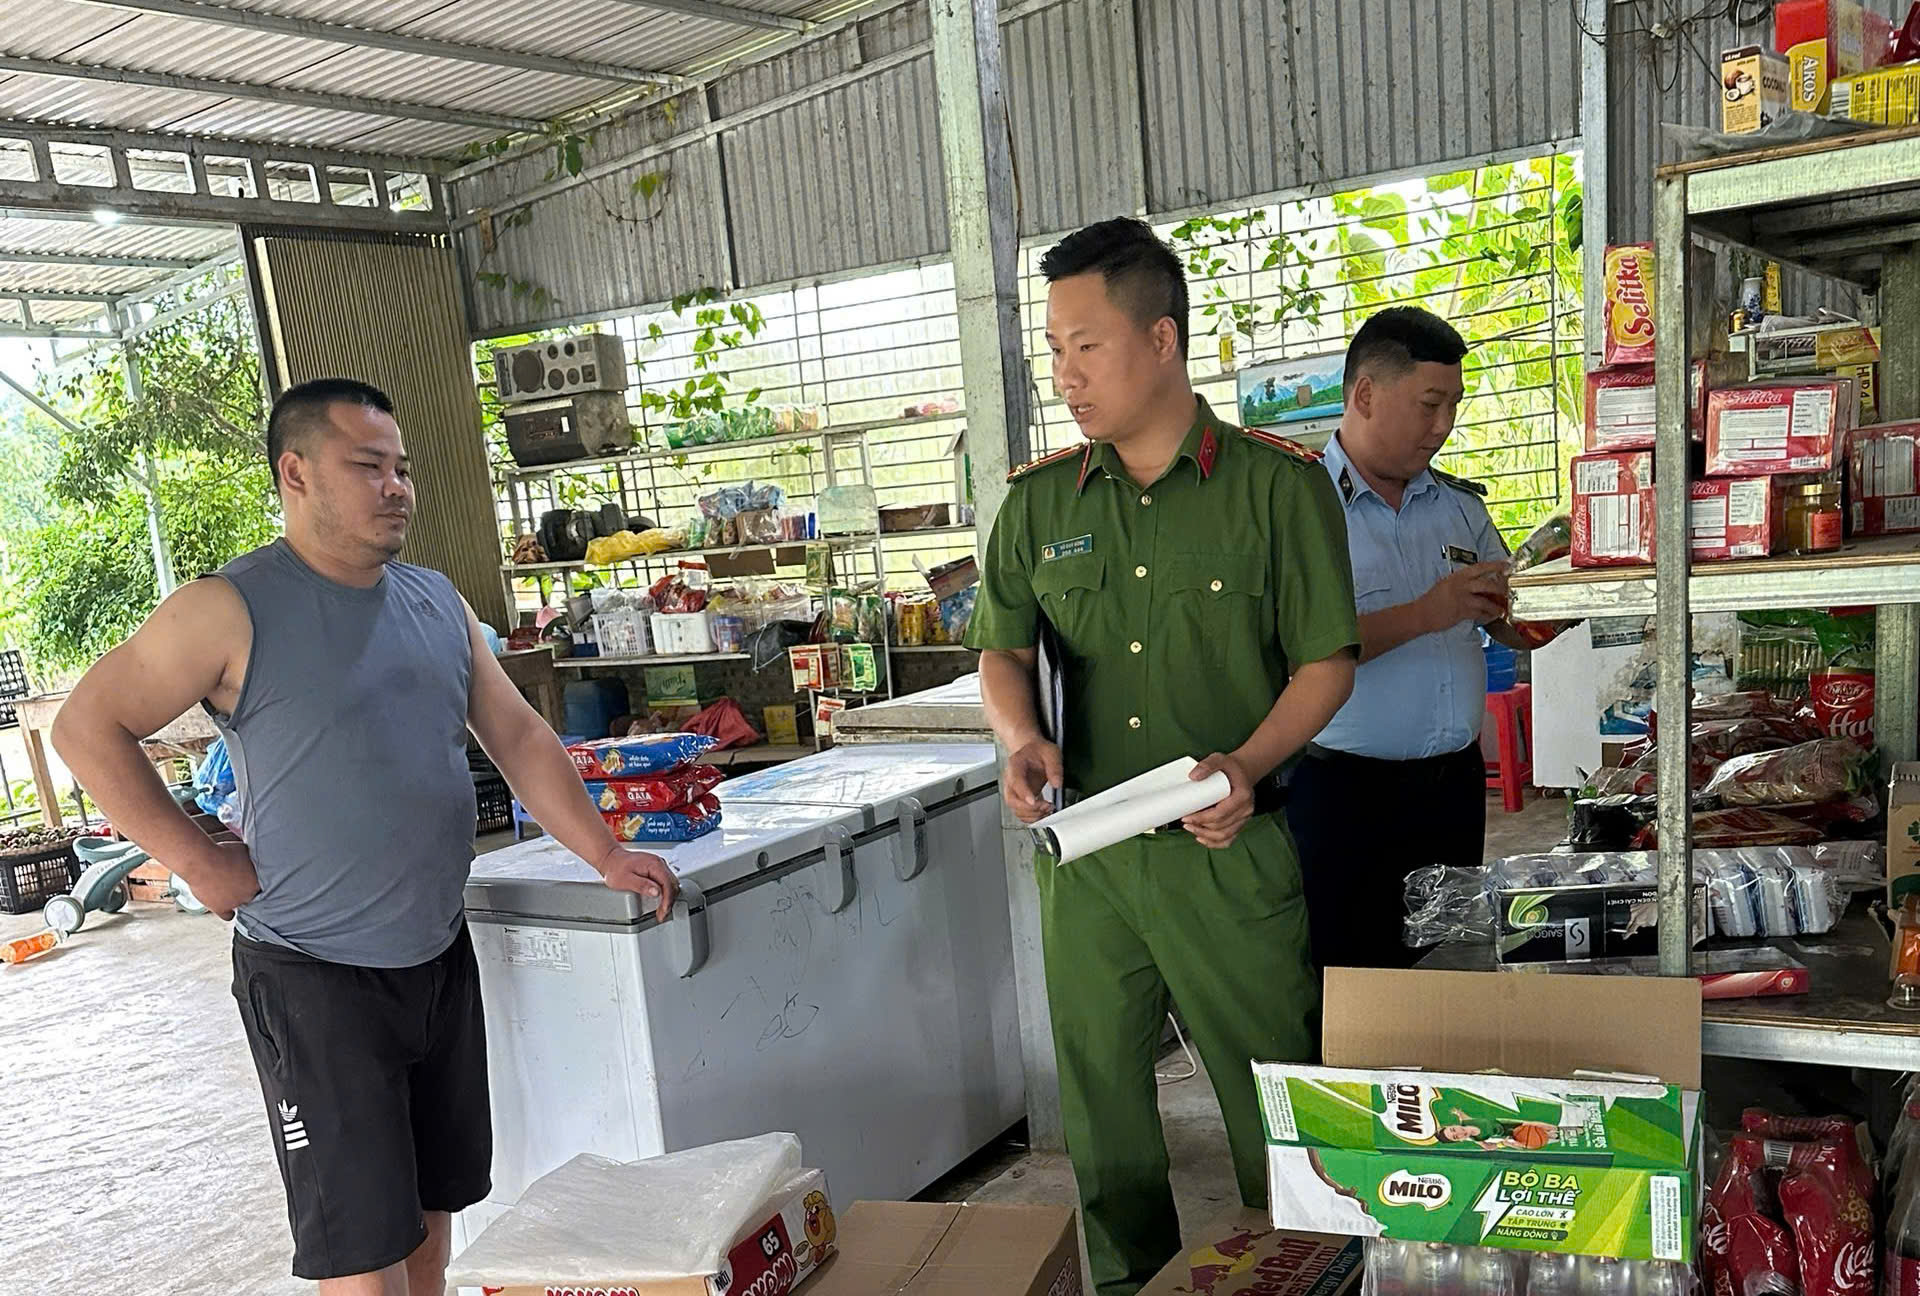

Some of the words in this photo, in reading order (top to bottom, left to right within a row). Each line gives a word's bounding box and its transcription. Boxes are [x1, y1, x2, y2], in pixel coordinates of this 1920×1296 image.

[1396, 1083, 1423, 1134] MILO
[1503, 1168, 1540, 1190] BỘ
[1543, 1173, 1580, 1190] BA
[1389, 1180, 1443, 1199] MILO
[1500, 1188, 1532, 1205] LỢI
[1535, 1189, 1582, 1206] THẾ
[1515, 1208, 1536, 1217] CAO
[1526, 1219, 1557, 1228] TRUNG
[761, 1230, 780, 1255] 65
[1328, 1250, 1358, 1274] Drink
